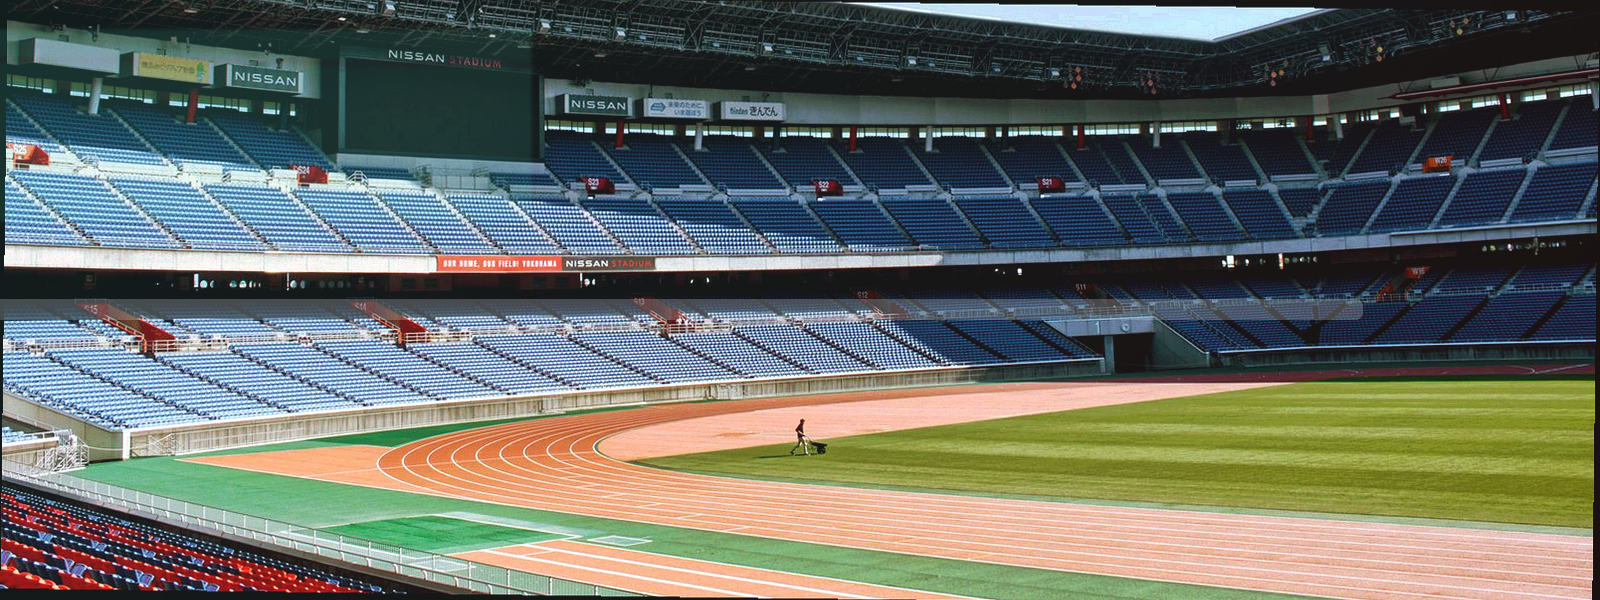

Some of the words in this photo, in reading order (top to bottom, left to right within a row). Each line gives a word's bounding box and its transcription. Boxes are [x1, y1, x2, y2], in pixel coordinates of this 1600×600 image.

[388, 49, 445, 63] NISSAN
[449, 56, 501, 69] STADIUM
[235, 71, 297, 87] NISSAN
[571, 100, 626, 111] NISSAN
[749, 106, 778, 117] きんでん
[443, 259, 457, 268] OUR
[483, 259, 496, 268] OUR
[522, 259, 557, 268] YOKOHAMA
[565, 259, 609, 268] NISSAN
[611, 259, 652, 268] STADIUM
